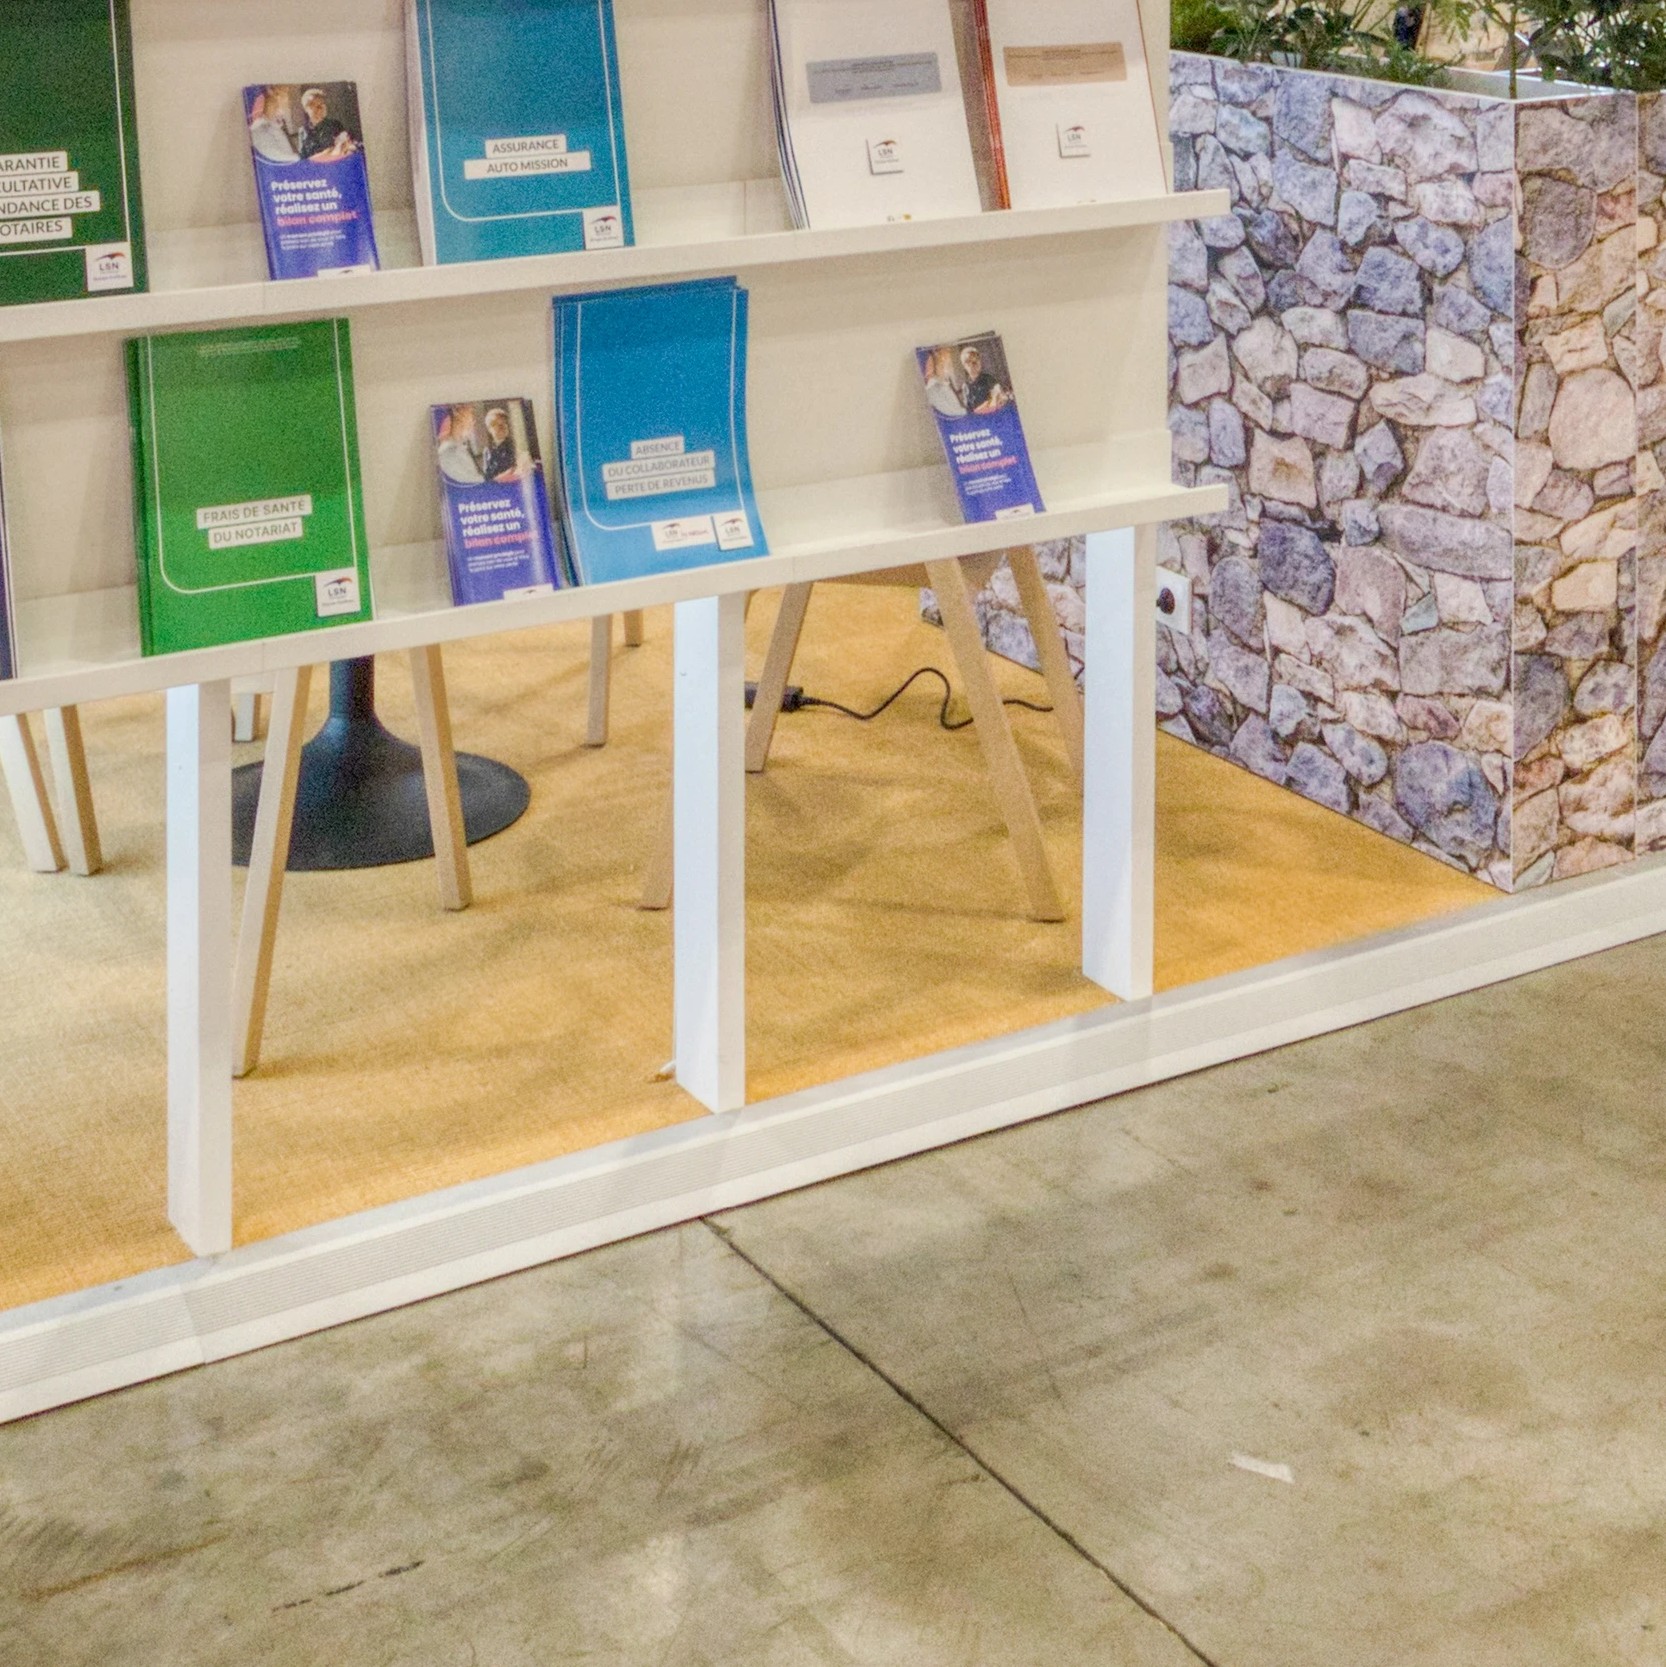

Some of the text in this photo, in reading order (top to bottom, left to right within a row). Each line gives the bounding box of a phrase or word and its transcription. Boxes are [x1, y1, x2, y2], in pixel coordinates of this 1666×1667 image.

[493, 139, 559, 153] ASSURANCE
[487, 158, 568, 173] AUTO MISSION
[271, 179, 327, 191] Préservez
[64, 195, 92, 210] DES
[273, 188, 342, 203] votre santé,
[276, 201, 337, 214] réalisez un
[99, 262, 119, 271] LSN
[950, 429, 991, 442] Préservez
[636, 441, 680, 454] ABSENCE
[953, 443, 975, 453] votre
[989, 449, 1001, 457] un
[608, 455, 709, 477] DU COLLABORATEUR
[615, 474, 708, 494] PERTE DE REVENUS
[204, 499, 305, 523] FRAIS DE SANTÉ
[458, 499, 511, 513] Préservez
[460, 508, 525, 525] votre santé,
[213, 522, 297, 543] DU NOTARIAT
[462, 521, 520, 537] réalisez un
[328, 587, 347, 596] LSN
